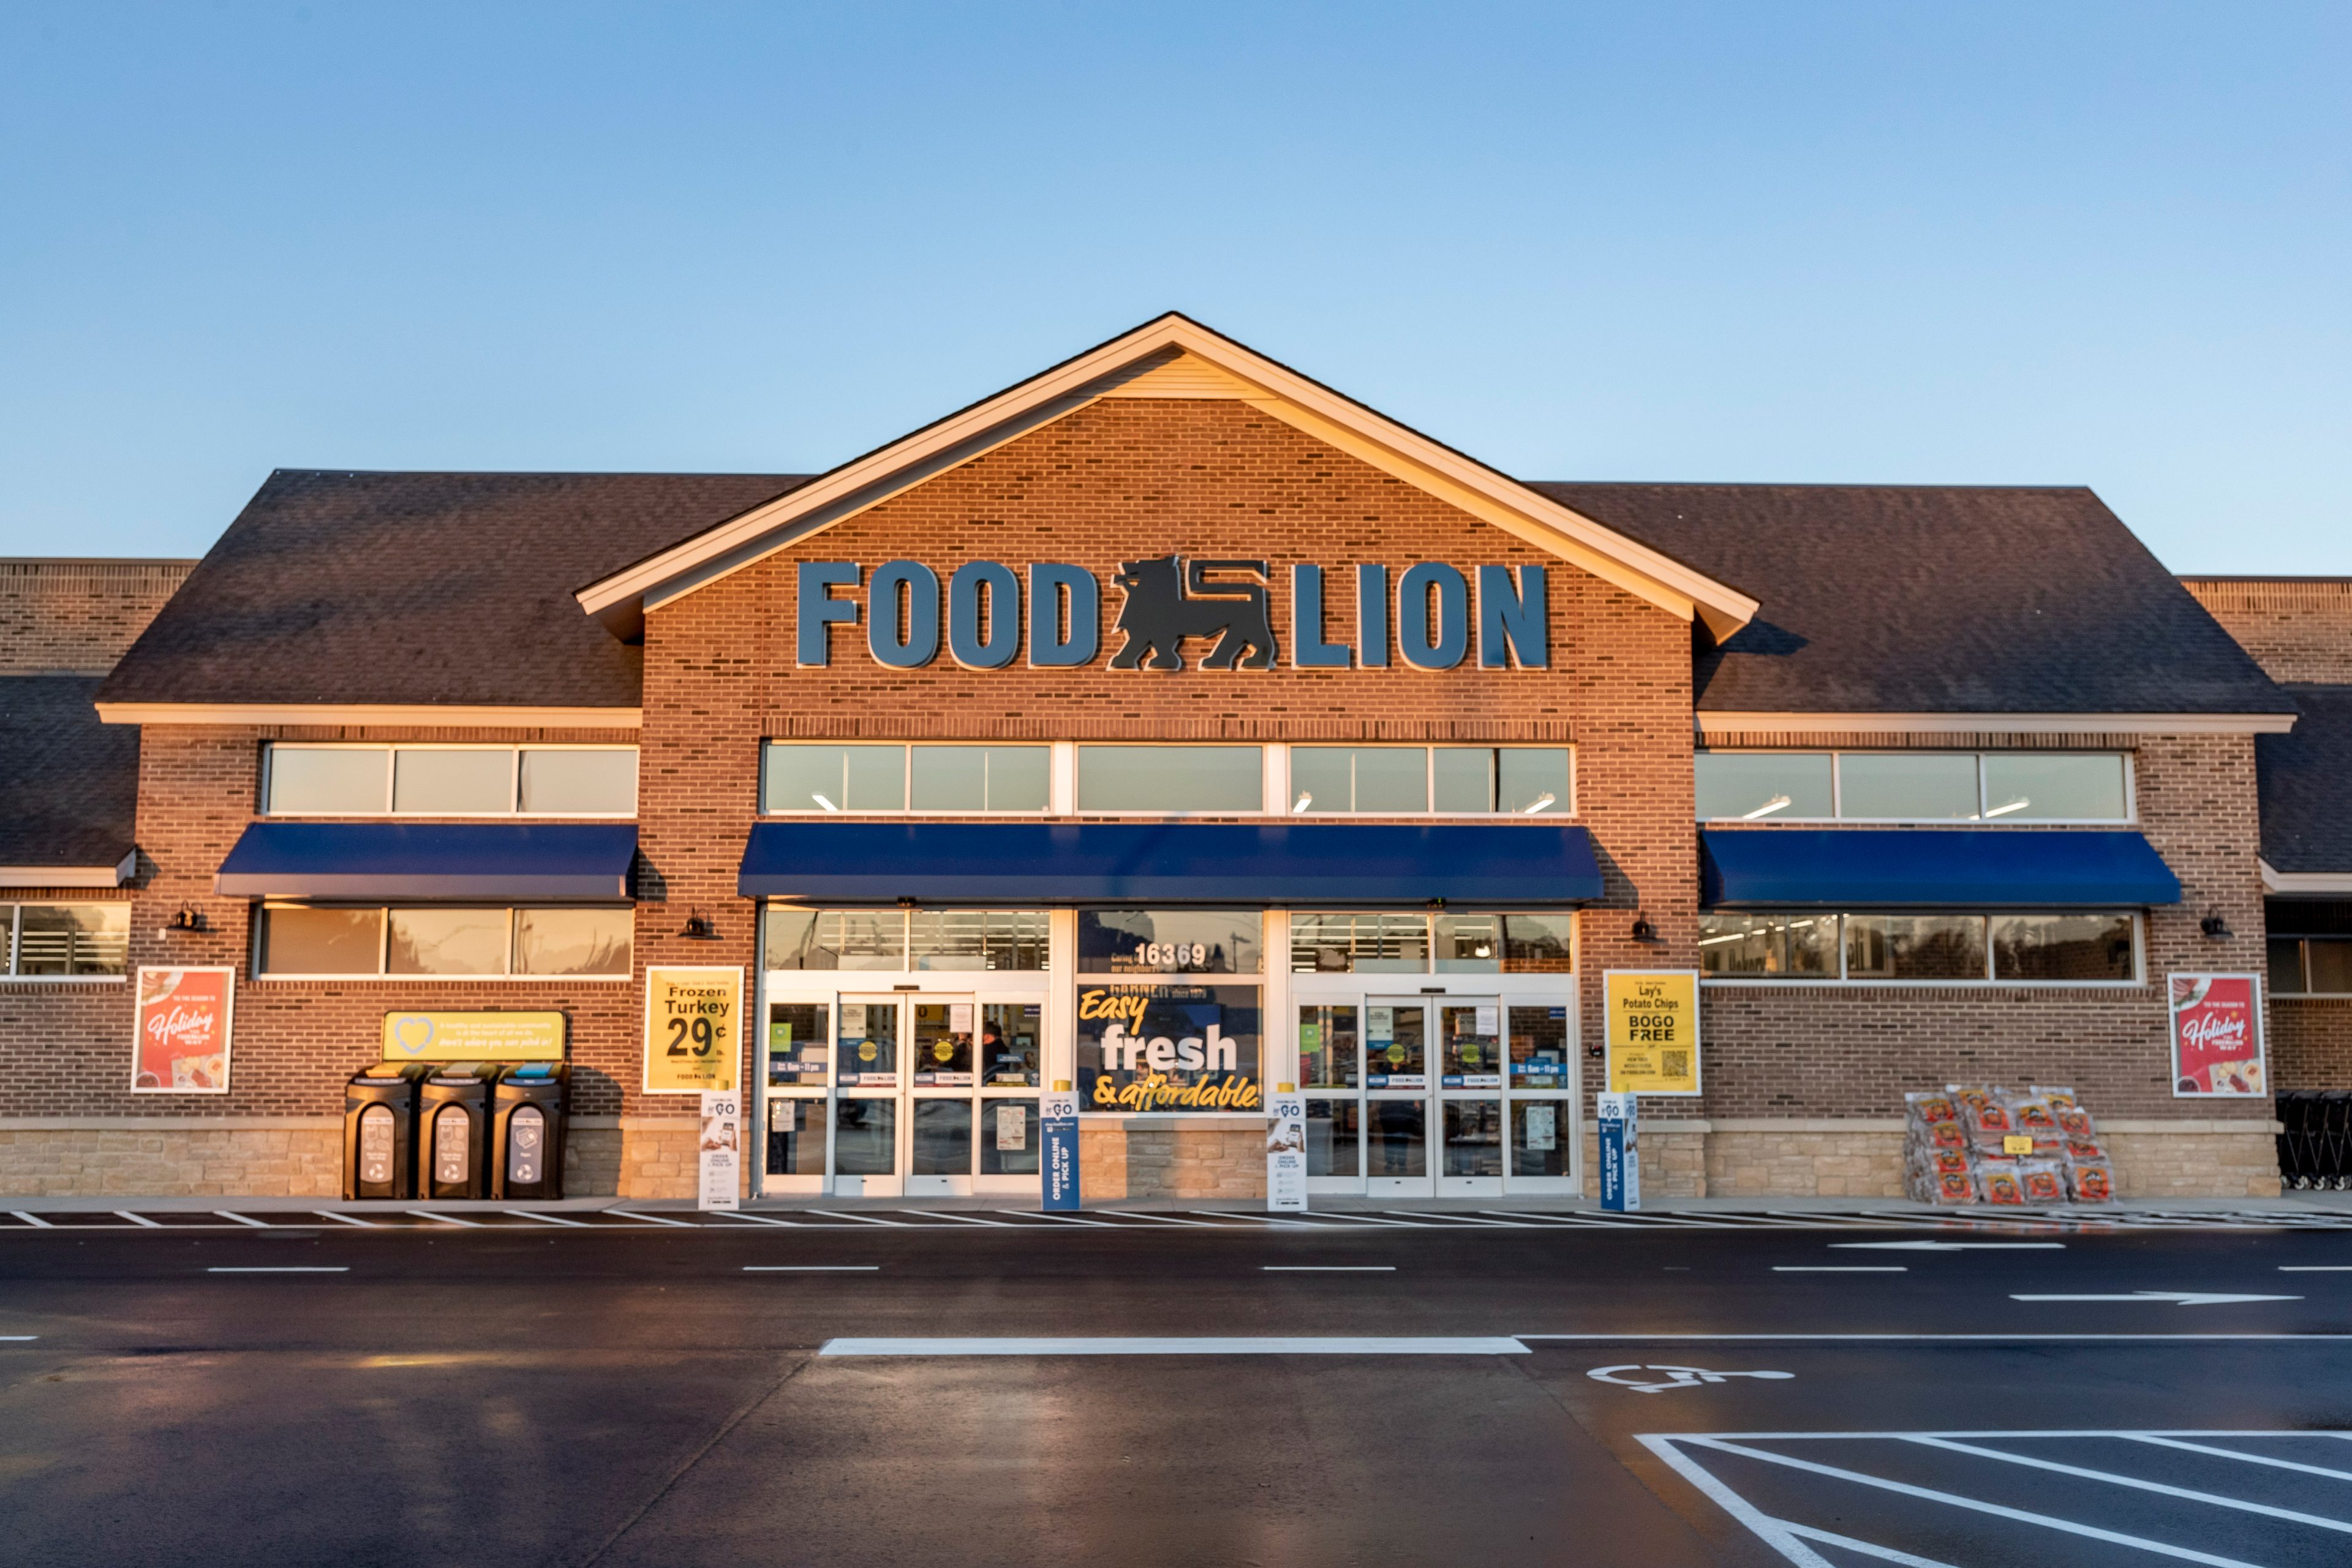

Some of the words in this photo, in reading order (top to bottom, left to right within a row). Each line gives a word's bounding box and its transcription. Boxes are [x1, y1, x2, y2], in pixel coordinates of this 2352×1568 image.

[796, 560, 1098, 671] FOOD
[1291, 562, 1547, 673] LION
[1136, 943, 1205, 965] 16369
[669, 987, 726, 997] Frozen
[1639, 986, 1662, 998] Lay's
[665, 1000, 729, 1017] Turkey
[1079, 990, 1148, 1035] Easy
[1623, 998, 1651, 1009] Potato
[1654, 998, 1679, 1011] Chips
[147, 1005, 214, 1046] Holiday
[1629, 1016, 1674, 1028] BOGO
[2182, 1011, 2246, 1052] Holiday
[667, 1017, 712, 1056] 29
[715, 1023, 726, 1041] ¢
[1630, 1029, 1675, 1041] FREE
[1101, 1024, 1237, 1070] fresh
[1093, 1076, 1118, 1104] &
[1118, 1074, 1259, 1111] affordable
[716, 1103, 734, 1116] GO
[1054, 1104, 1072, 1116] GO
[1281, 1105, 1299, 1117] GO
[1052, 1137, 1060, 1169] ONLINE
[1061, 1147, 1069, 1159] UP
[1052, 1172, 1061, 1200] ORDER
